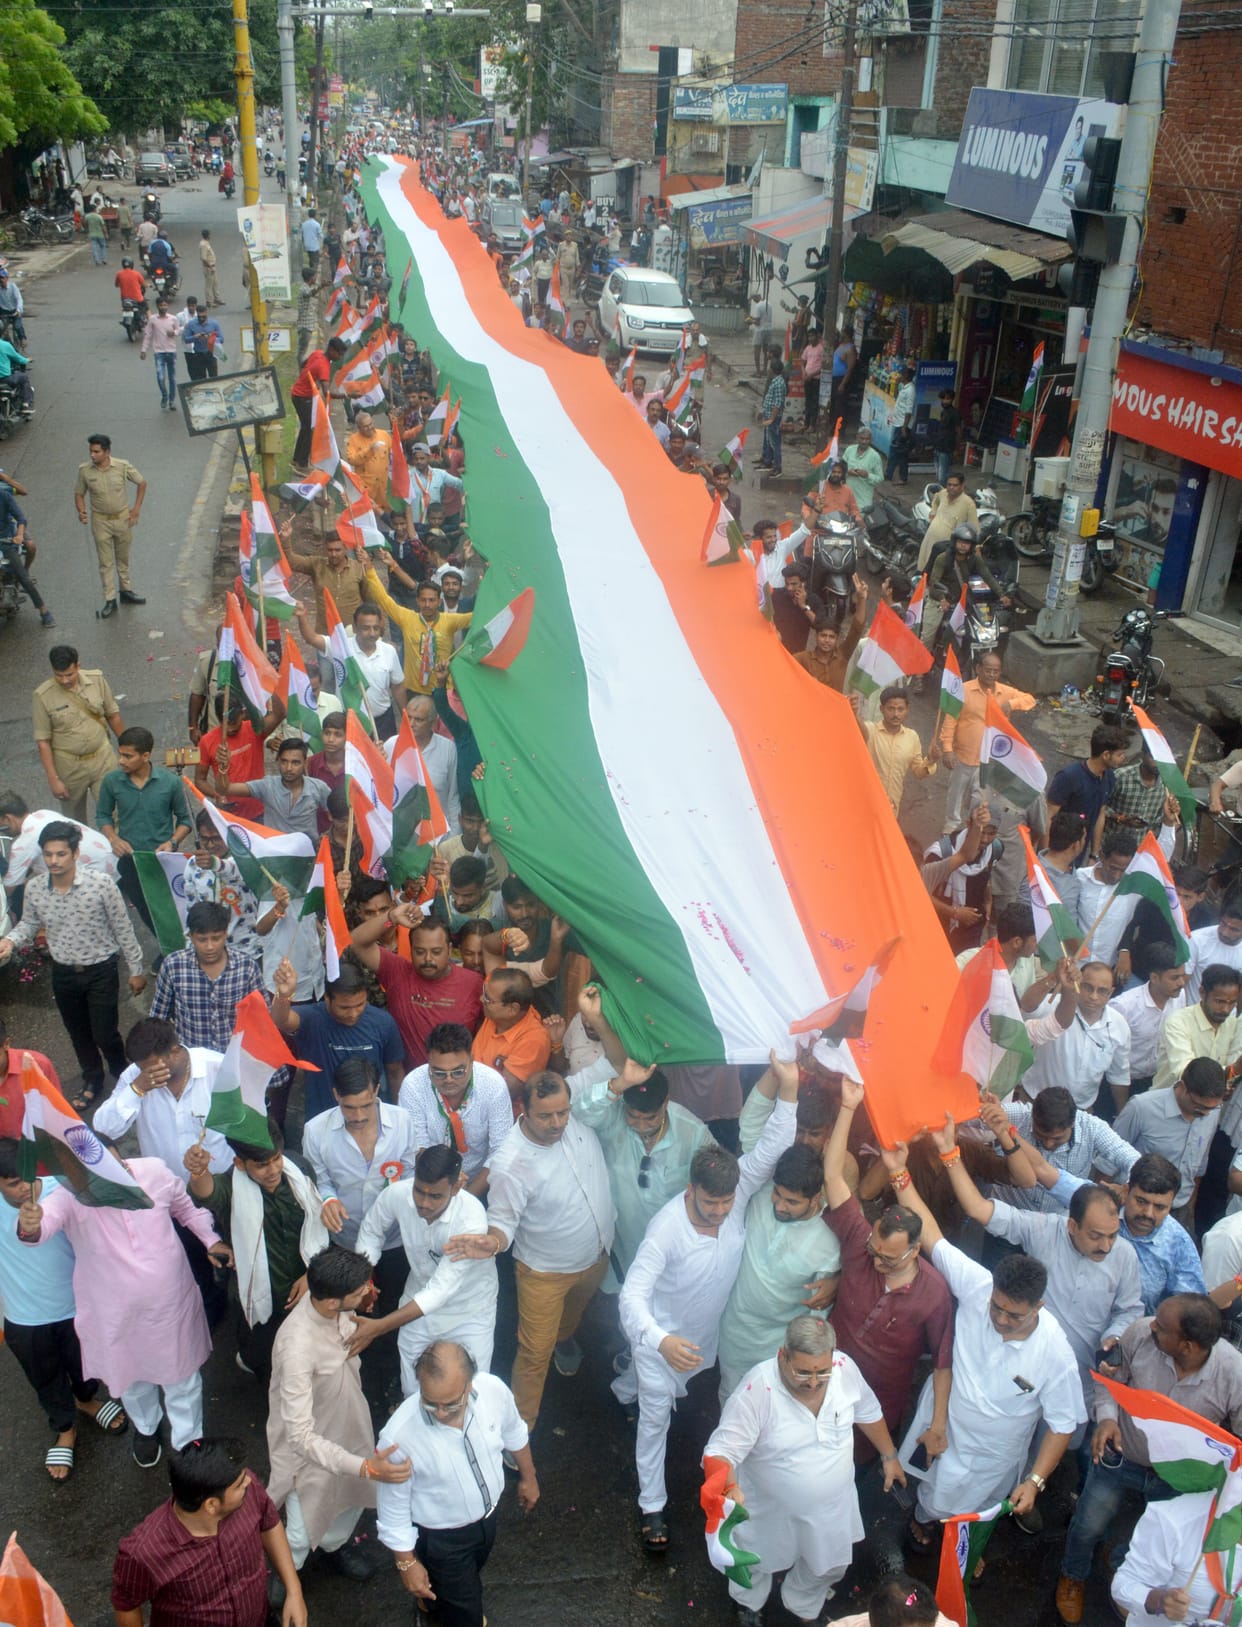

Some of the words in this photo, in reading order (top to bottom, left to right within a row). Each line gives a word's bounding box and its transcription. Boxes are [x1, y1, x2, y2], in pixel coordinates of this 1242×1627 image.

[729, 86, 748, 108] देव
[961, 124, 1048, 180] LUMINOUS
[596, 197, 615, 206] BUY
[601, 206, 609, 217] 2
[693, 208, 715, 225] देव
[596, 216, 610, 226] GE
[920, 367, 954, 376] LUMINOUS
[1112, 378, 1166, 420] MOUS
[1168, 397, 1219, 439] HAIR
